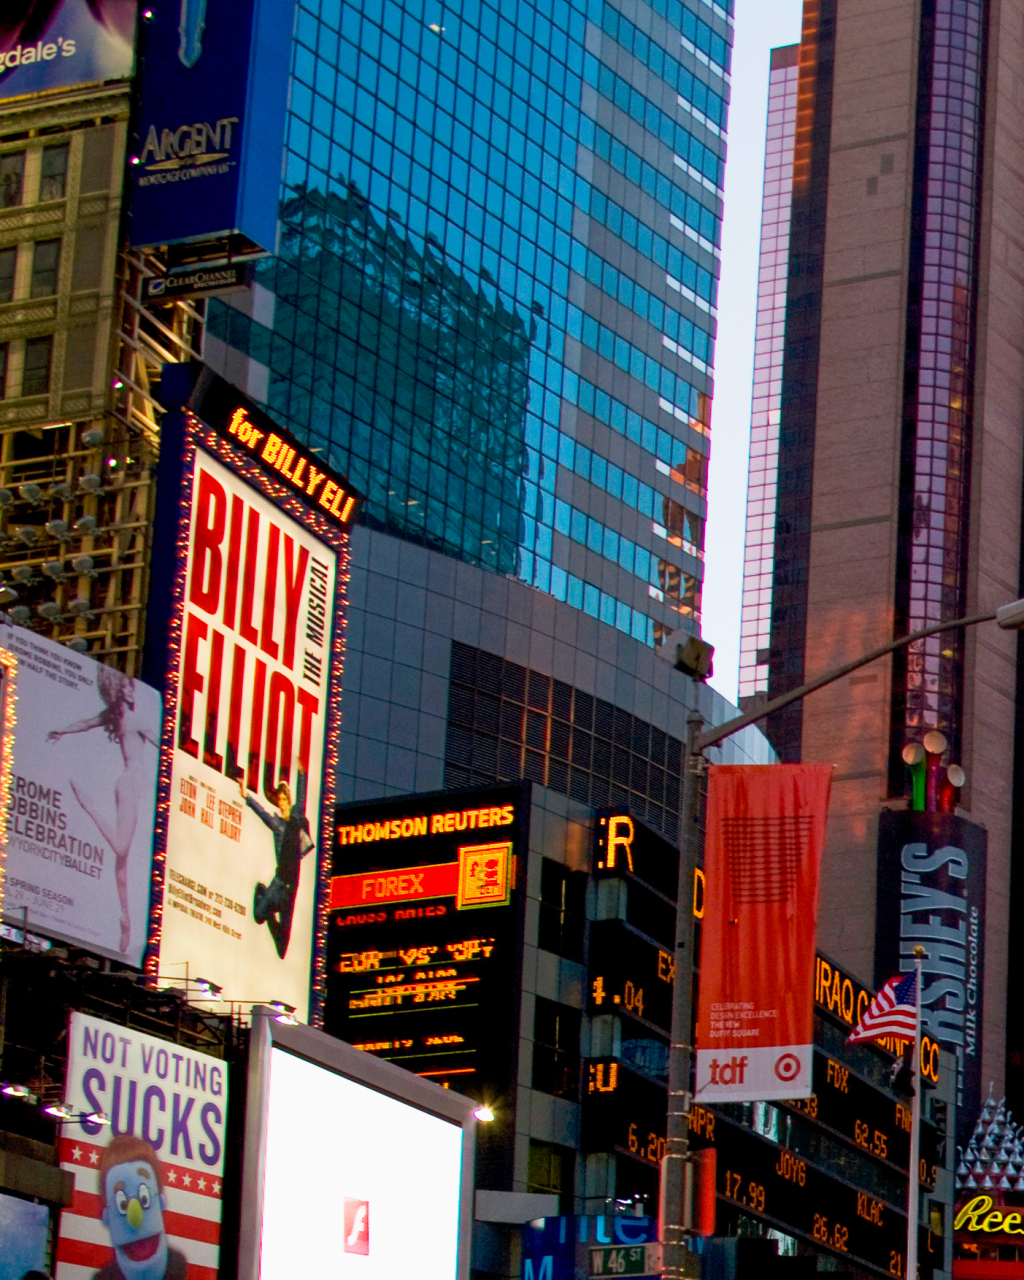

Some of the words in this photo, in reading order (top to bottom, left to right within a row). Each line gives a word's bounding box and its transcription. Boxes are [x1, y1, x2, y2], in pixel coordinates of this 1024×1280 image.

[140, 117, 239, 163] ARGENT
[228, 407, 264, 449] for
[261, 433, 326, 497] BILLY
[319, 480, 356, 523] ELI
[188, 467, 310, 672] BILLY
[305, 556, 330, 647] MUSICAL
[302, 647, 323, 688] THE
[177, 611, 320, 807] ELLIOT
[7, 793, 67, 831] OBBINS
[9, 774, 63, 810] EROME
[6, 814, 104, 866] ELEBRATION
[337, 816, 429, 845] THOMSON
[430, 805, 515, 834] REUTERS
[10, 878, 40, 896] SPRING
[42, 888, 74, 907] SEASON
[361, 873, 425, 900] FOREX
[899, 842, 969, 1106] RSHEY'S
[967, 906, 979, 1006] Chocolate
[815, 957, 854, 1022] IRAQ
[710, 1021, 724, 1029] THE
[732, 1028, 760, 1038] SQUARE
[735, 1009, 778, 1019] EXCELLENCE
[965, 1010, 977, 1057] Milk
[83, 1026, 132, 1068] NOT
[140, 1043, 223, 1097] VOTING
[708, 1055, 749, 1086] tdf
[827, 1058, 849, 1094] FDX
[79, 1067, 223, 1167] SUCKS
[854, 1119, 888, 1159] 62.55
[775, 1152, 807, 1187] JOYG
[725, 1170, 766, 1212] 17.99
[857, 1191, 884, 1227] KLAC
[813, 1213, 849, 1251] 26.62
[591, 1250, 604, 1274] W
[607, 1251, 626, 1274] 46
[629, 1247, 642, 1261] ST
